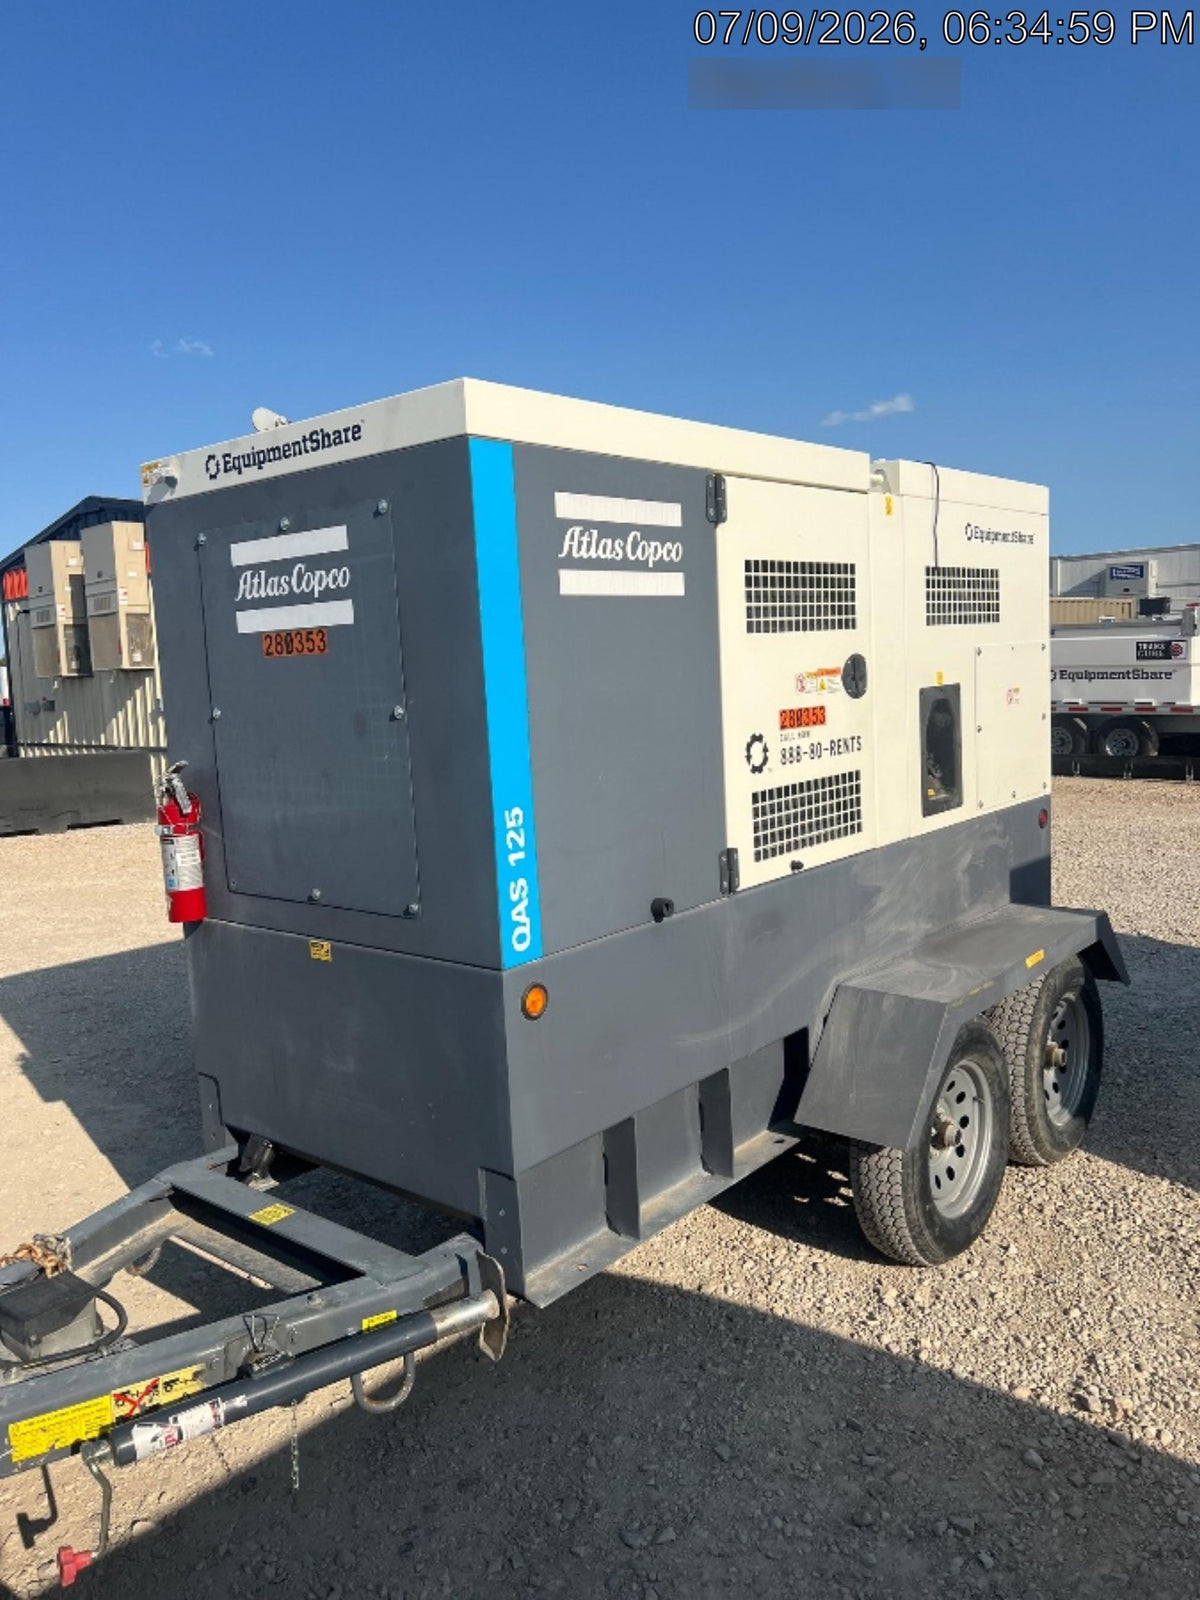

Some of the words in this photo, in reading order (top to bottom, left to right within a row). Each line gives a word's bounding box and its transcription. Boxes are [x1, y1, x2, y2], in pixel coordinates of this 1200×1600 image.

[222, 423, 362, 475] EquipmentShare
[557, 526, 624, 560] Atlas
[626, 530, 683, 568] Copco
[235, 569, 290, 602] Atlas
[291, 563, 351, 599] Copco
[263, 629, 327, 657] 280353
[1060, 668, 1173, 682] EquipmentShare
[779, 705, 826, 731] 280353
[780, 735, 862, 765] 888-80-RENTS
[504, 806, 526, 868] 125
[509, 877, 532, 952] QAS
